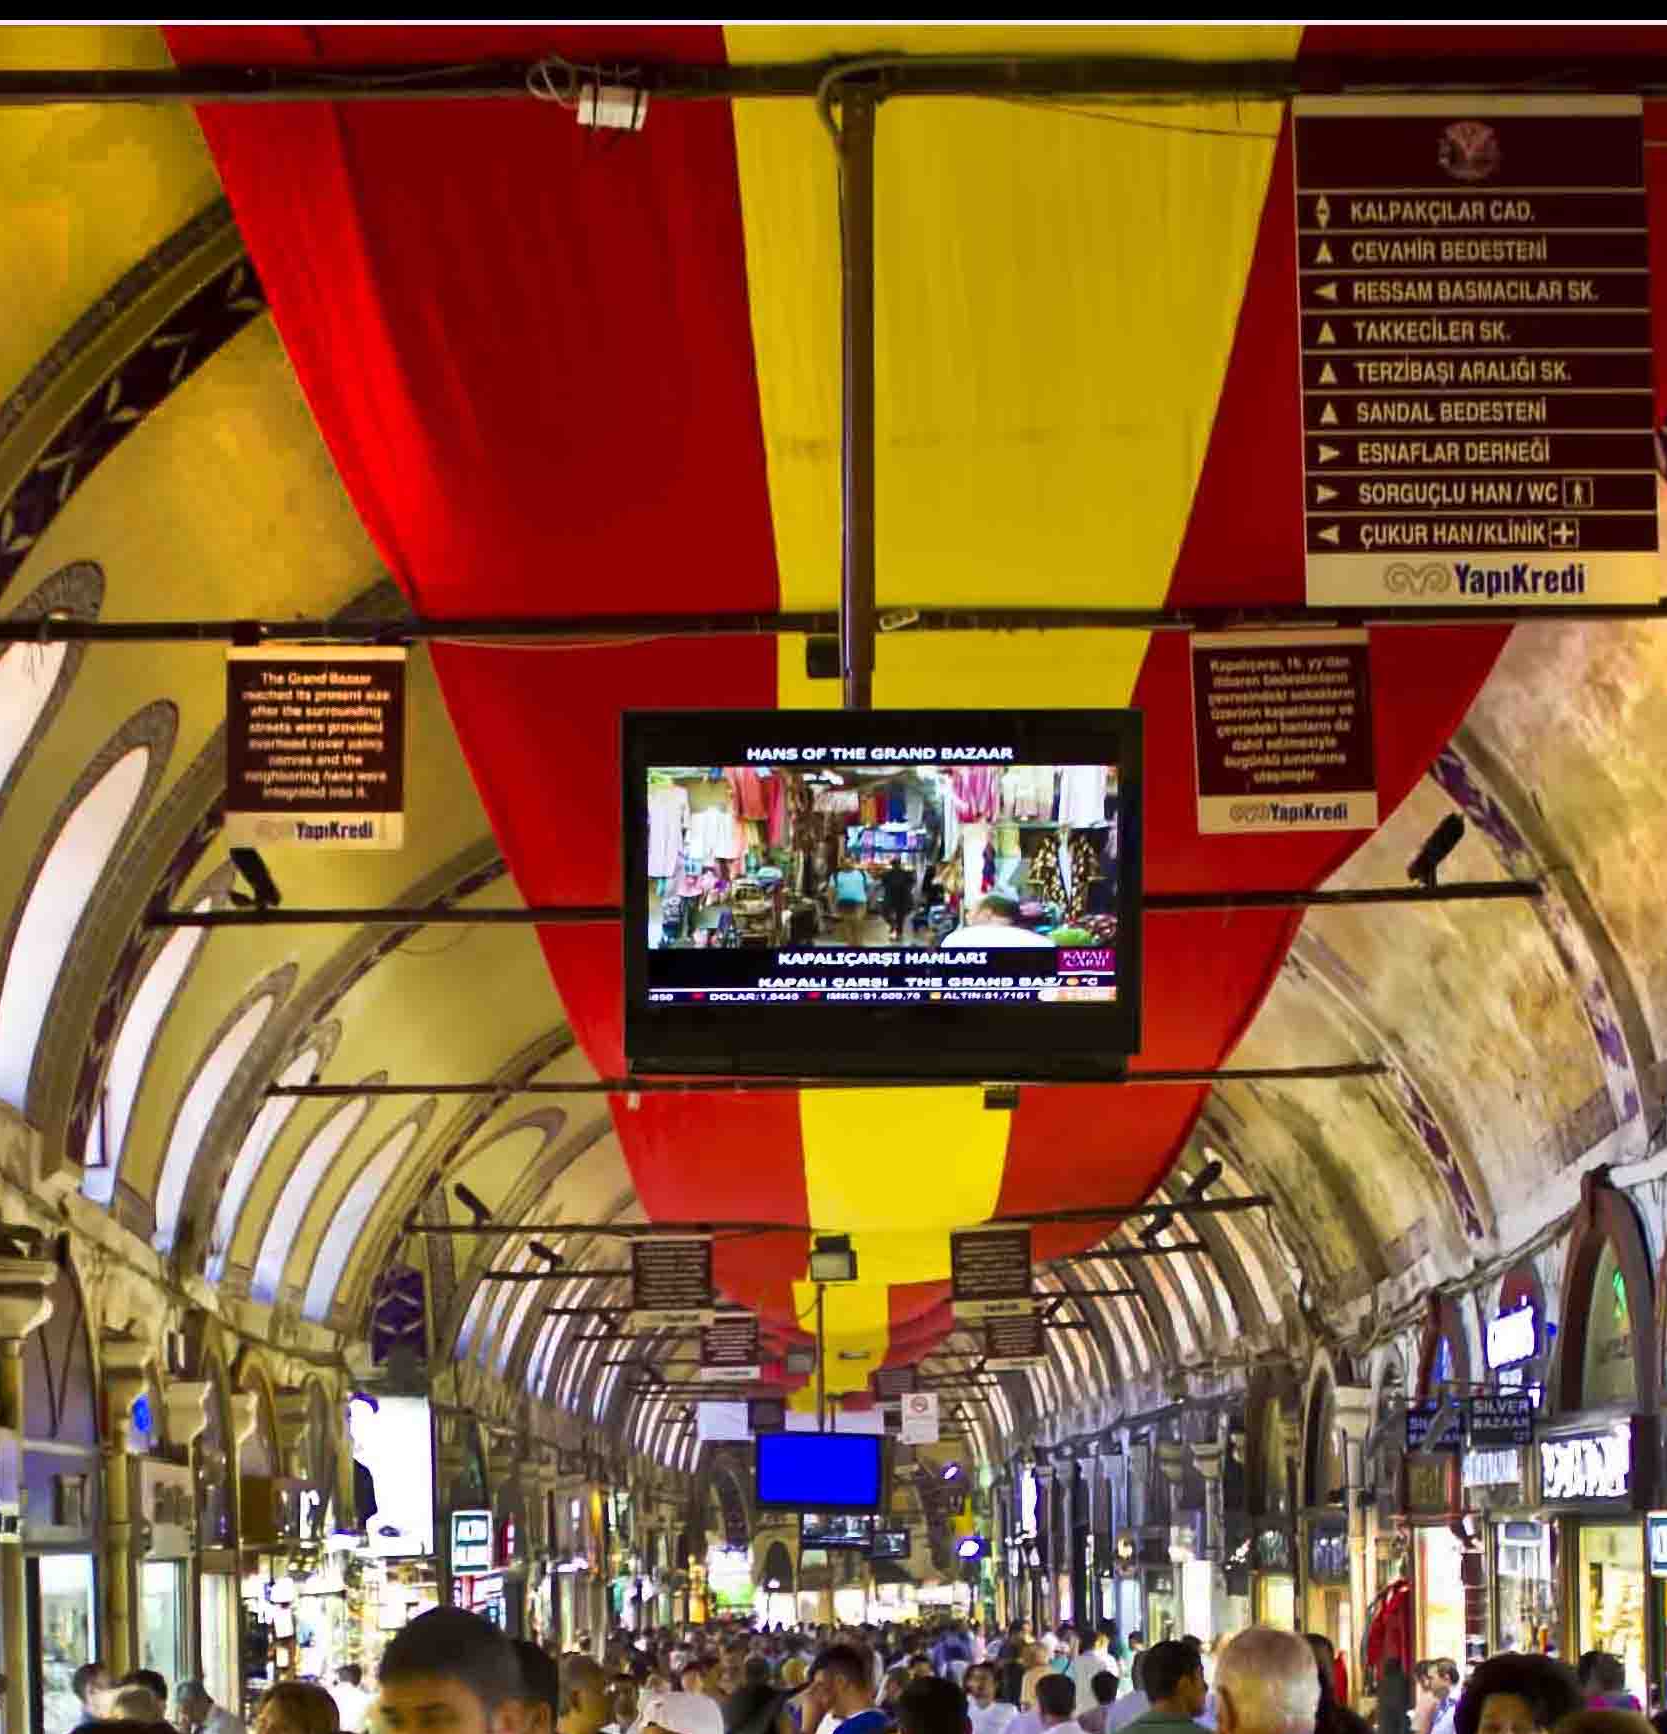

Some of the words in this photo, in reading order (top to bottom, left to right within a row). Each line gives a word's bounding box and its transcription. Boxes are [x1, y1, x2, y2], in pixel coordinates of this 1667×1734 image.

[1351, 201, 1485, 225] KALPAKÇILAR
[1490, 200, 1535, 222] CAD.
[1352, 236, 1435, 262] CEVAHİR
[1440, 235, 1547, 260] BEDESTENİ
[1353, 280, 1433, 302] RESSAM
[1438, 280, 1562, 302] BASMACILAR
[1567, 280, 1598, 301] SK.
[1353, 317, 1474, 341] TAKKECİLER
[1479, 321, 1511, 340] SK.
[1355, 354, 1454, 385] TERZİBAŞI
[1459, 357, 1535, 381] ARALIĞI
[1541, 360, 1571, 381] SK.
[1356, 402, 1435, 423] SANDAL
[1440, 396, 1546, 422] BEDESTENİ
[1358, 442, 1459, 464] ESNAFLAR
[1465, 436, 1550, 462] DERNEĞİ
[1359, 483, 1464, 509] SORGUÇLU
[1470, 482, 1510, 503] HAN
[1526, 481, 1558, 503] WC
[1360, 523, 1427, 551] ÇUKUR
[261, 673, 283, 684] The
[288, 672, 326, 685] Grand
[747, 747, 799, 761] HANS
[802, 747, 827, 761] OF
[831, 747, 867, 761] THE
[870, 747, 937, 761] GRAND
[940, 747, 1014, 761] BAZAAR
[778, 952, 901, 967] KAPALIÇARŞI
[905, 952, 988, 965] HANLARI
[758, 977, 827, 988] KAPALI
[905, 977, 943, 988] THE
[947, 977, 1014, 987] GRAND
[1473, 1399, 1529, 1414] SILVER
